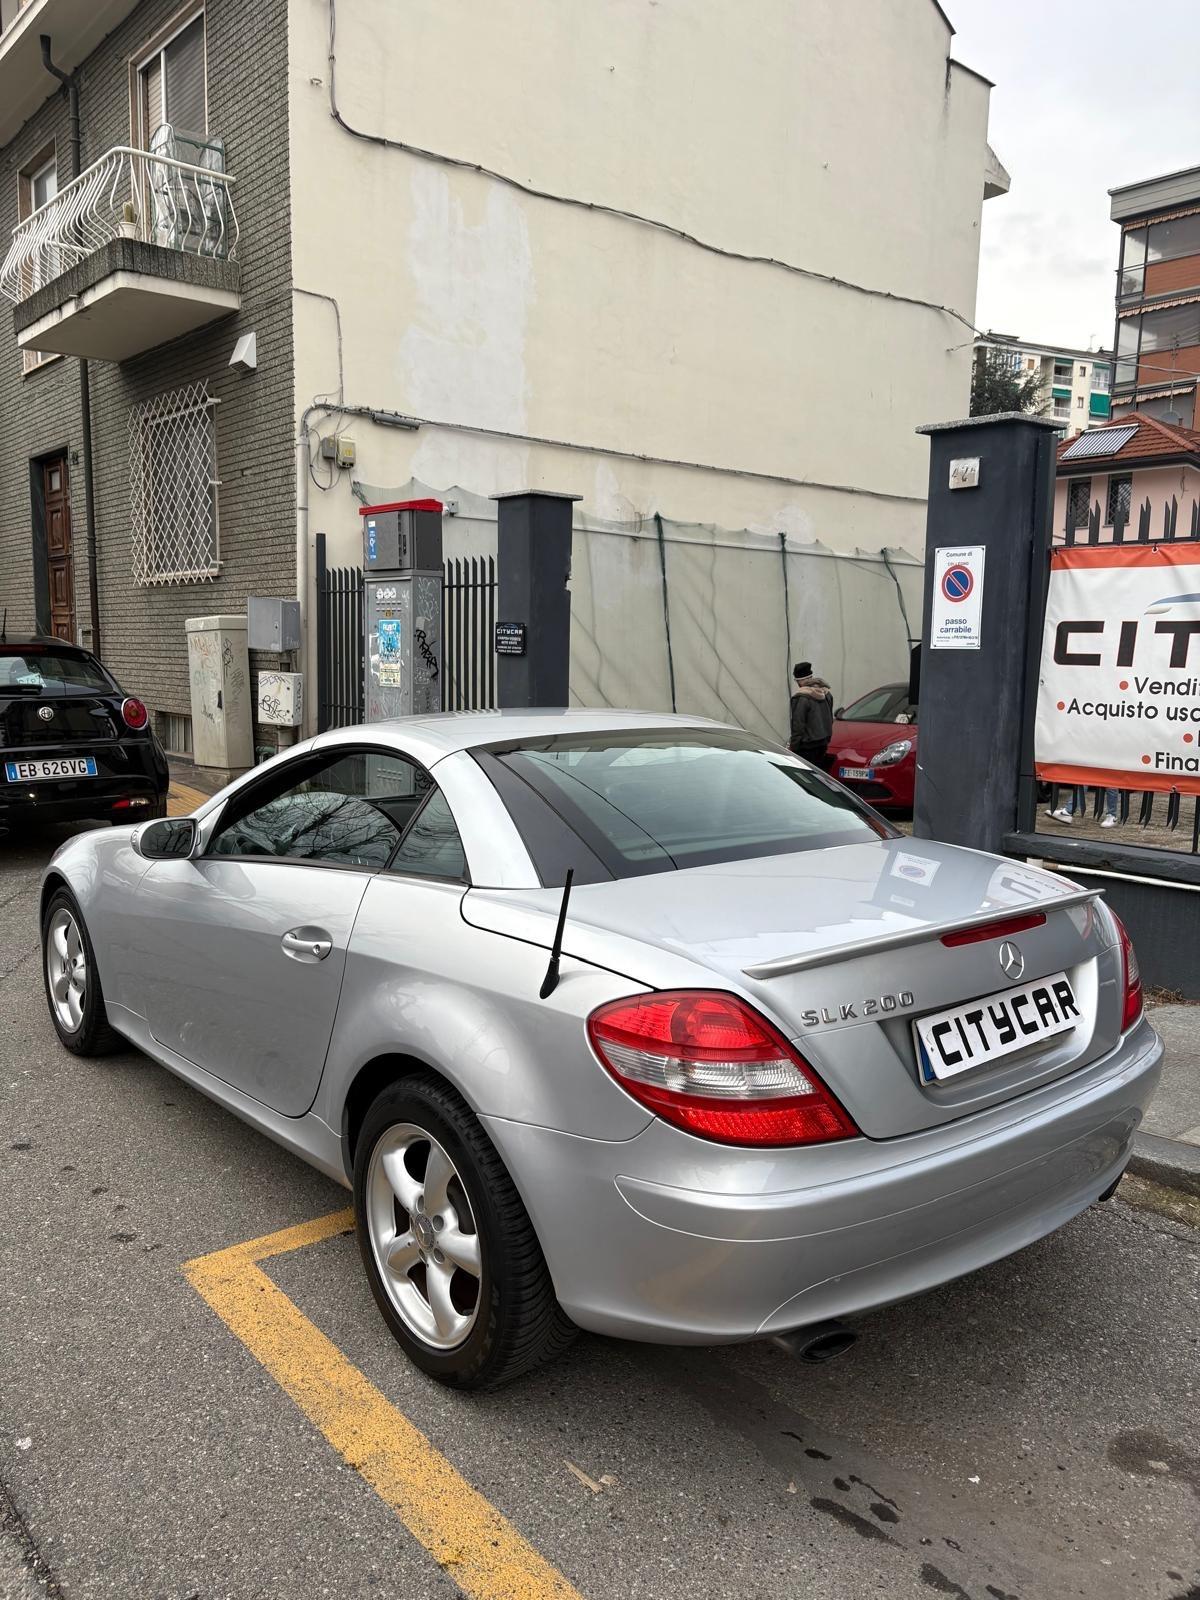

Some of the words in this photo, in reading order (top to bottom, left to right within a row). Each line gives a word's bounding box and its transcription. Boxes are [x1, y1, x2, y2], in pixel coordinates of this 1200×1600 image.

[939, 626, 972, 634] carrabile
[945, 618, 967, 626] passo
[1067, 698, 1158, 720] Acquisto
[43, 760, 87, 776] 626VG
[800, 1002, 858, 1027] SLK
[863, 991, 915, 1016] 200
[931, 980, 1081, 1067] CITYCAR
